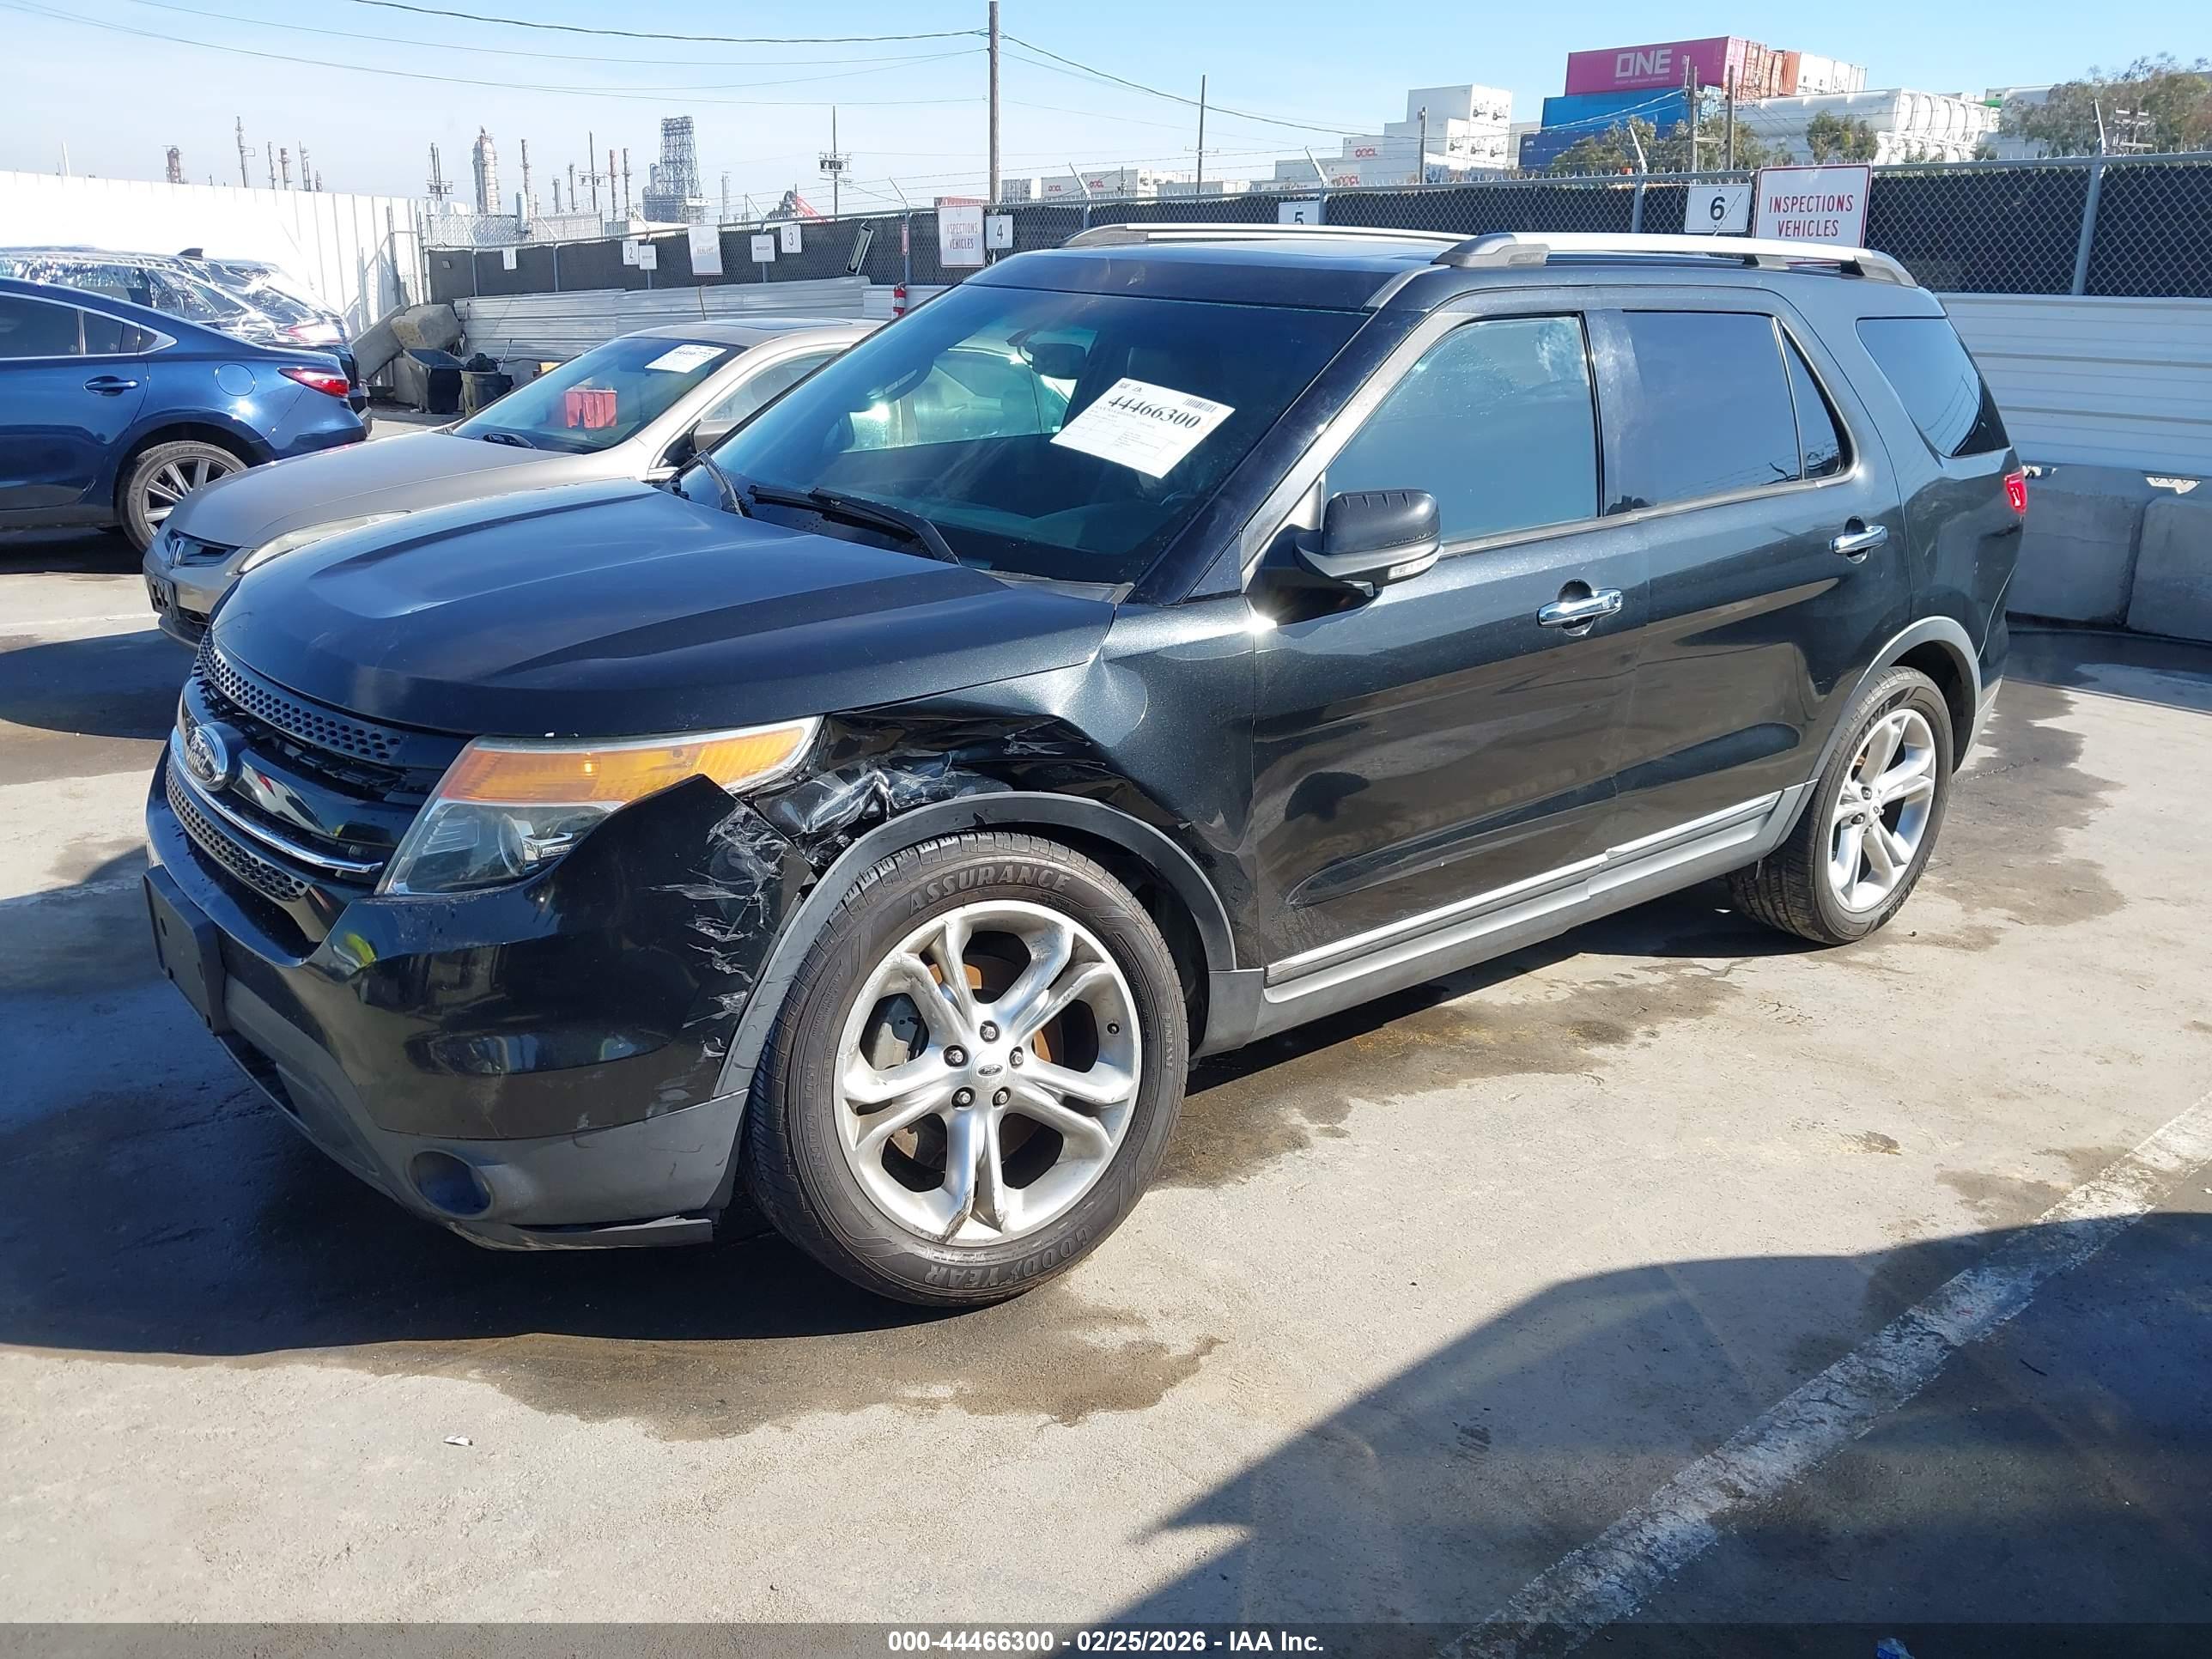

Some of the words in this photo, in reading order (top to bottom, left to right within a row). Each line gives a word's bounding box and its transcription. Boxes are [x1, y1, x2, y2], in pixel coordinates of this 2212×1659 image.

[1614, 49, 1672, 77] ONE
[1355, 148, 1377, 157] OOCL
[1710, 196, 1726, 221] 6
[1768, 194, 1854, 214] INSPECTIONS
[1294, 211, 1304, 224] 5
[996, 223, 1004, 240] 4
[1778, 219, 1839, 237] VEHICLES
[788, 232, 794, 246] 3
[949, 238, 974, 250] VEHICLES
[629, 246, 634, 259] 2
[1108, 395, 1202, 429] 44466300
[185, 728, 210, 775] Ford
[909, 864, 1073, 915] ASSURANCE
